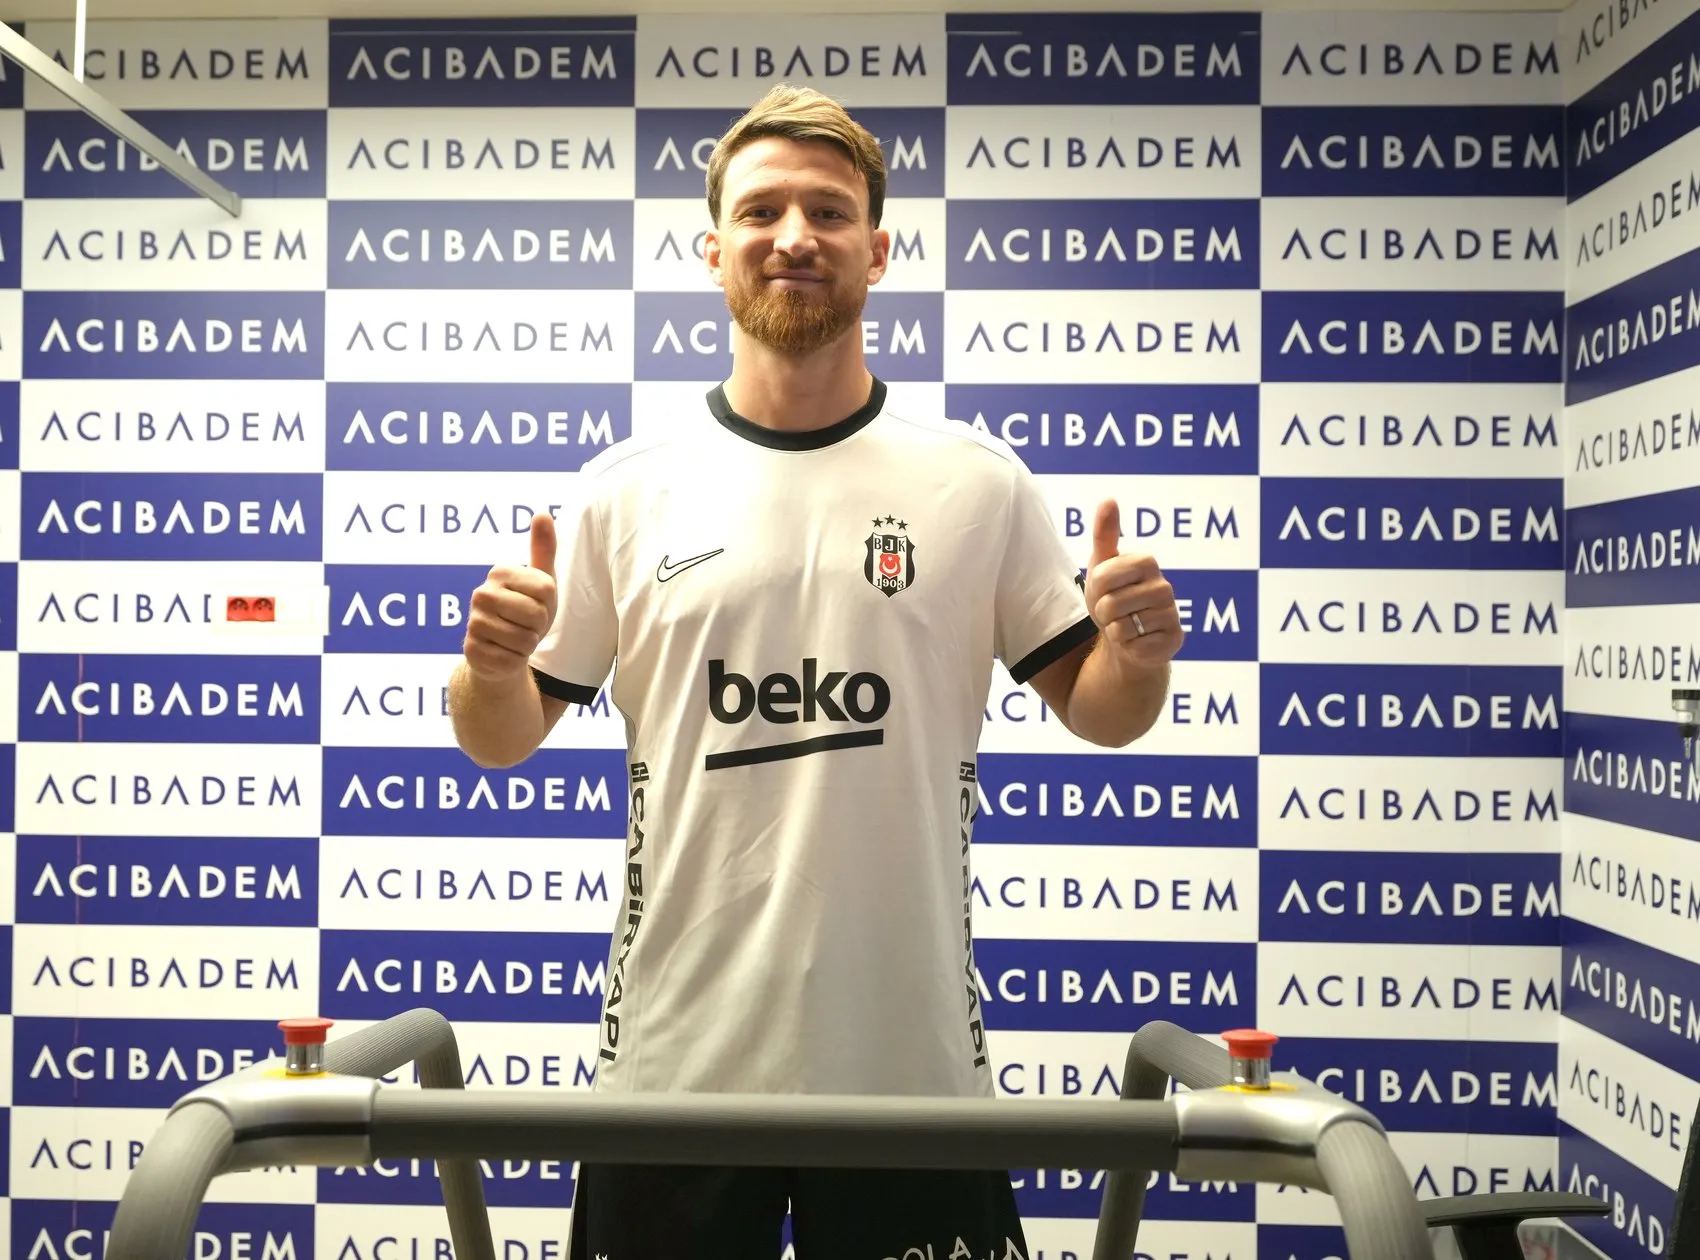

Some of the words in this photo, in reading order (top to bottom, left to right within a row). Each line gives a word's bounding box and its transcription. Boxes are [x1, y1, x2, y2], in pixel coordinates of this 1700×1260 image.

[348, 46, 616, 79] ACIBADEM
[656, 46, 926, 78] ACIBADEM
[967, 44, 1241, 77] ACIBADEM
[1282, 43, 1559, 75] ACIBADEM
[348, 139, 614, 169] ACIBADEM
[967, 137, 1240, 168] ACIBADEM
[1281, 135, 1558, 168] ACIBADEM
[43, 230, 306, 260] ACIBADEM
[346, 228, 615, 262] ACIBADEM
[965, 228, 1241, 261] ACIBADEM
[1282, 228, 1558, 260] ACIBADEM
[40, 319, 306, 352] ACIBADEM
[347, 322, 612, 351] ACIBADEM
[966, 322, 1240, 352] ACIBADEM
[1281, 320, 1558, 354] ACIBADEM
[41, 412, 304, 441] ACIBADEM
[344, 410, 614, 446] ACIBADEM
[1281, 415, 1557, 446] ACIBADEM
[38, 500, 305, 534] ACIBADEM
[1279, 506, 1558, 541] ACIBADEM
[874, 538, 906, 553] BJK
[876, 578, 905, 589] 1903
[38, 593, 212, 622] ACIBA
[341, 592, 462, 626] ACIB
[1280, 601, 1557, 634] ACIBADEM
[36, 682, 303, 716] ACIBADEM
[708, 658, 891, 724] beko
[1279, 692, 1558, 729] ACIBADEM
[37, 775, 300, 806] ACIBADEM
[340, 775, 610, 811] ACIBADEM
[1280, 788, 1558, 821] ACIBADEM
[33, 863, 301, 899] ACIBADEM
[340, 868, 608, 901] ACIBADEM
[1278, 880, 1559, 917] ACIBADEM
[33, 957, 298, 989] ACIBADEM
[337, 957, 607, 997] ACIBADEM
[1279, 975, 1558, 1010] ACIBADEM
[30, 1045, 277, 1081] ACIBADE
[1300, 1068, 1558, 1107] CIBADEM
[1570, 1059, 1681, 1151] ACIBADE
[1568, 1163, 1664, 1255] ACIBAD
